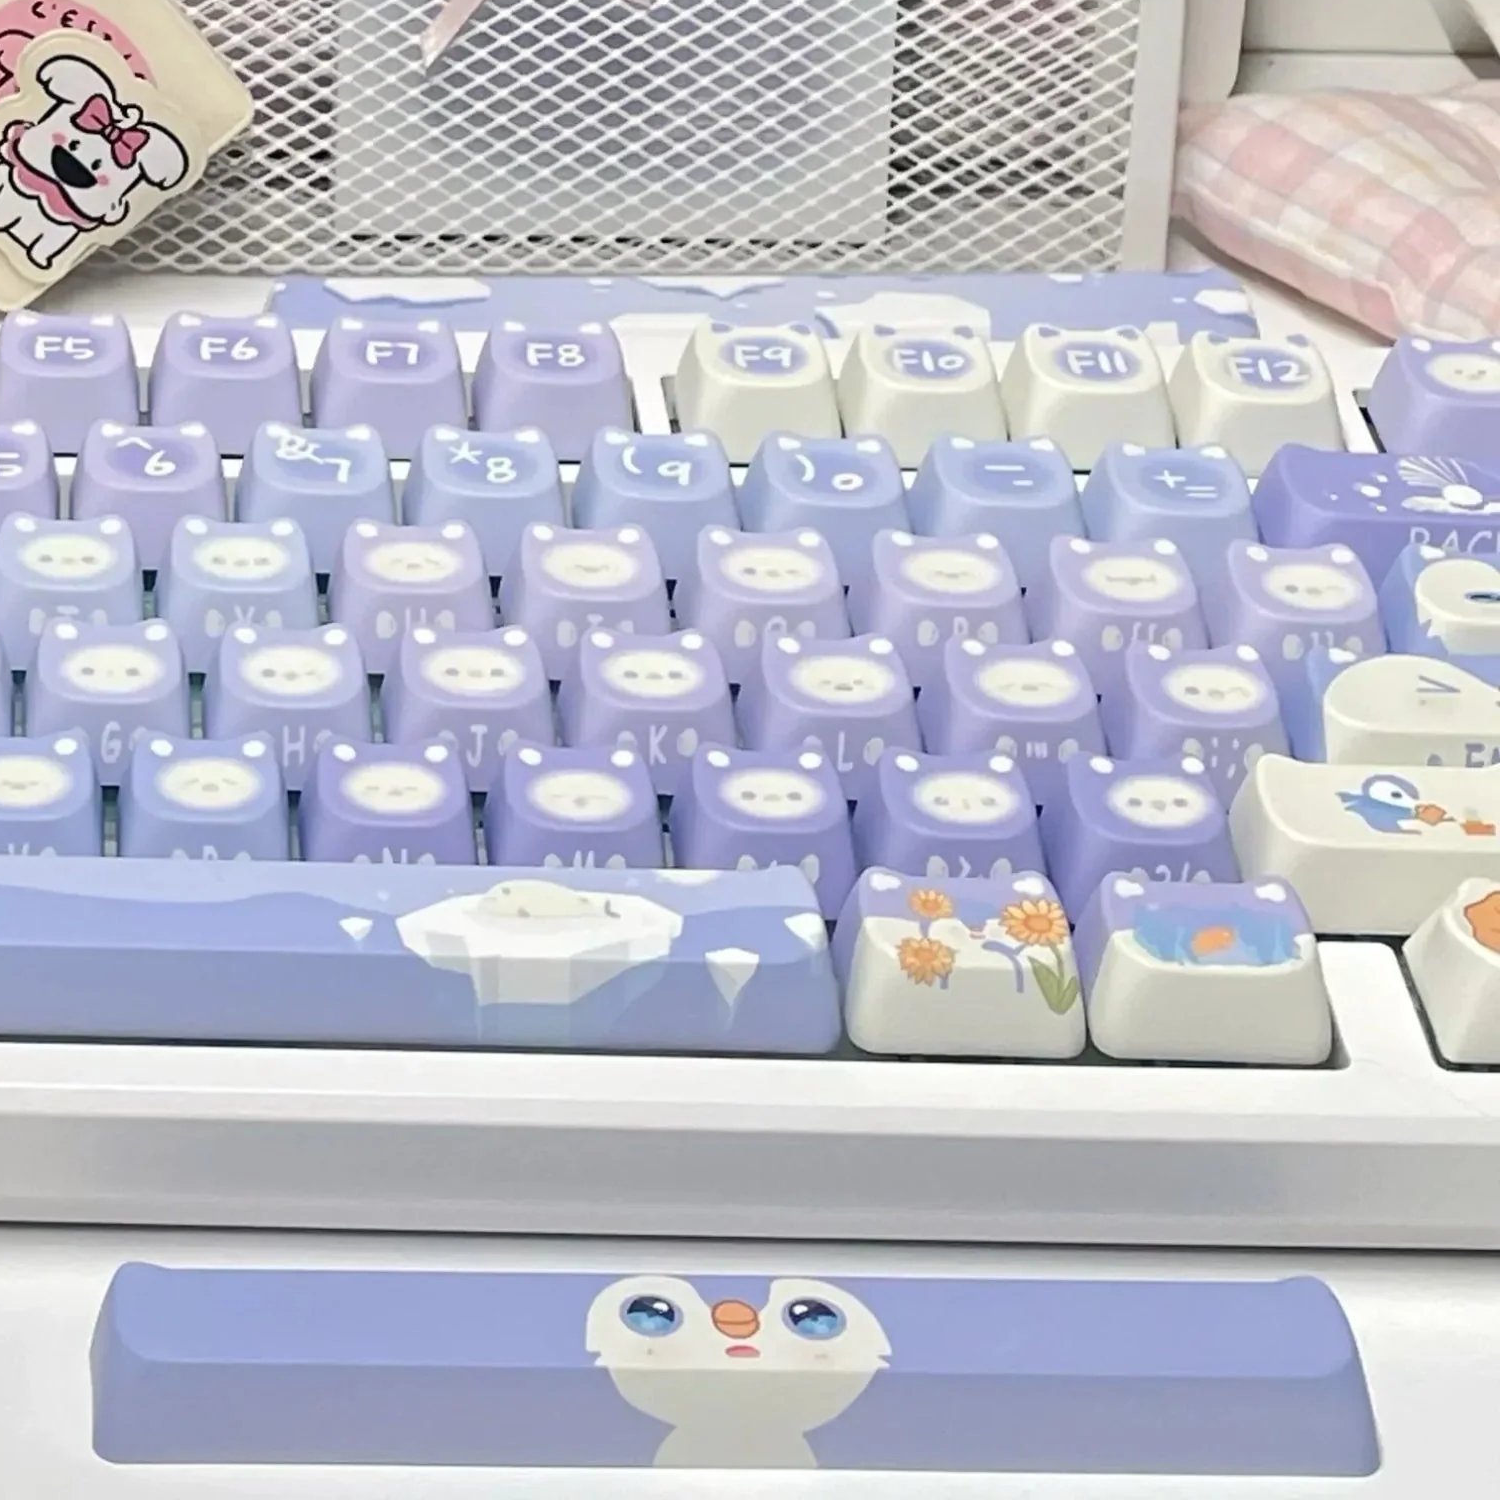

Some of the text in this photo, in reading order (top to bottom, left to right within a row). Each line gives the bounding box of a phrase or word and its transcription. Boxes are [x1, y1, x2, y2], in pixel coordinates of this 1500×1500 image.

[33, 335, 96, 361] F5
[200, 336, 260, 362] F6
[365, 340, 420, 367] F7
[525, 343, 586, 368] F8
[733, 344, 793, 371] F9
[893, 348, 966, 375] F10
[1066, 350, 1129, 376] F11
[1229, 355, 1310, 384] F12
[101, 720, 122, 764] G
[282, 725, 306, 768] H
[465, 723, 488, 768] J
[649, 724, 668, 766] K
[837, 729, 853, 773] L
